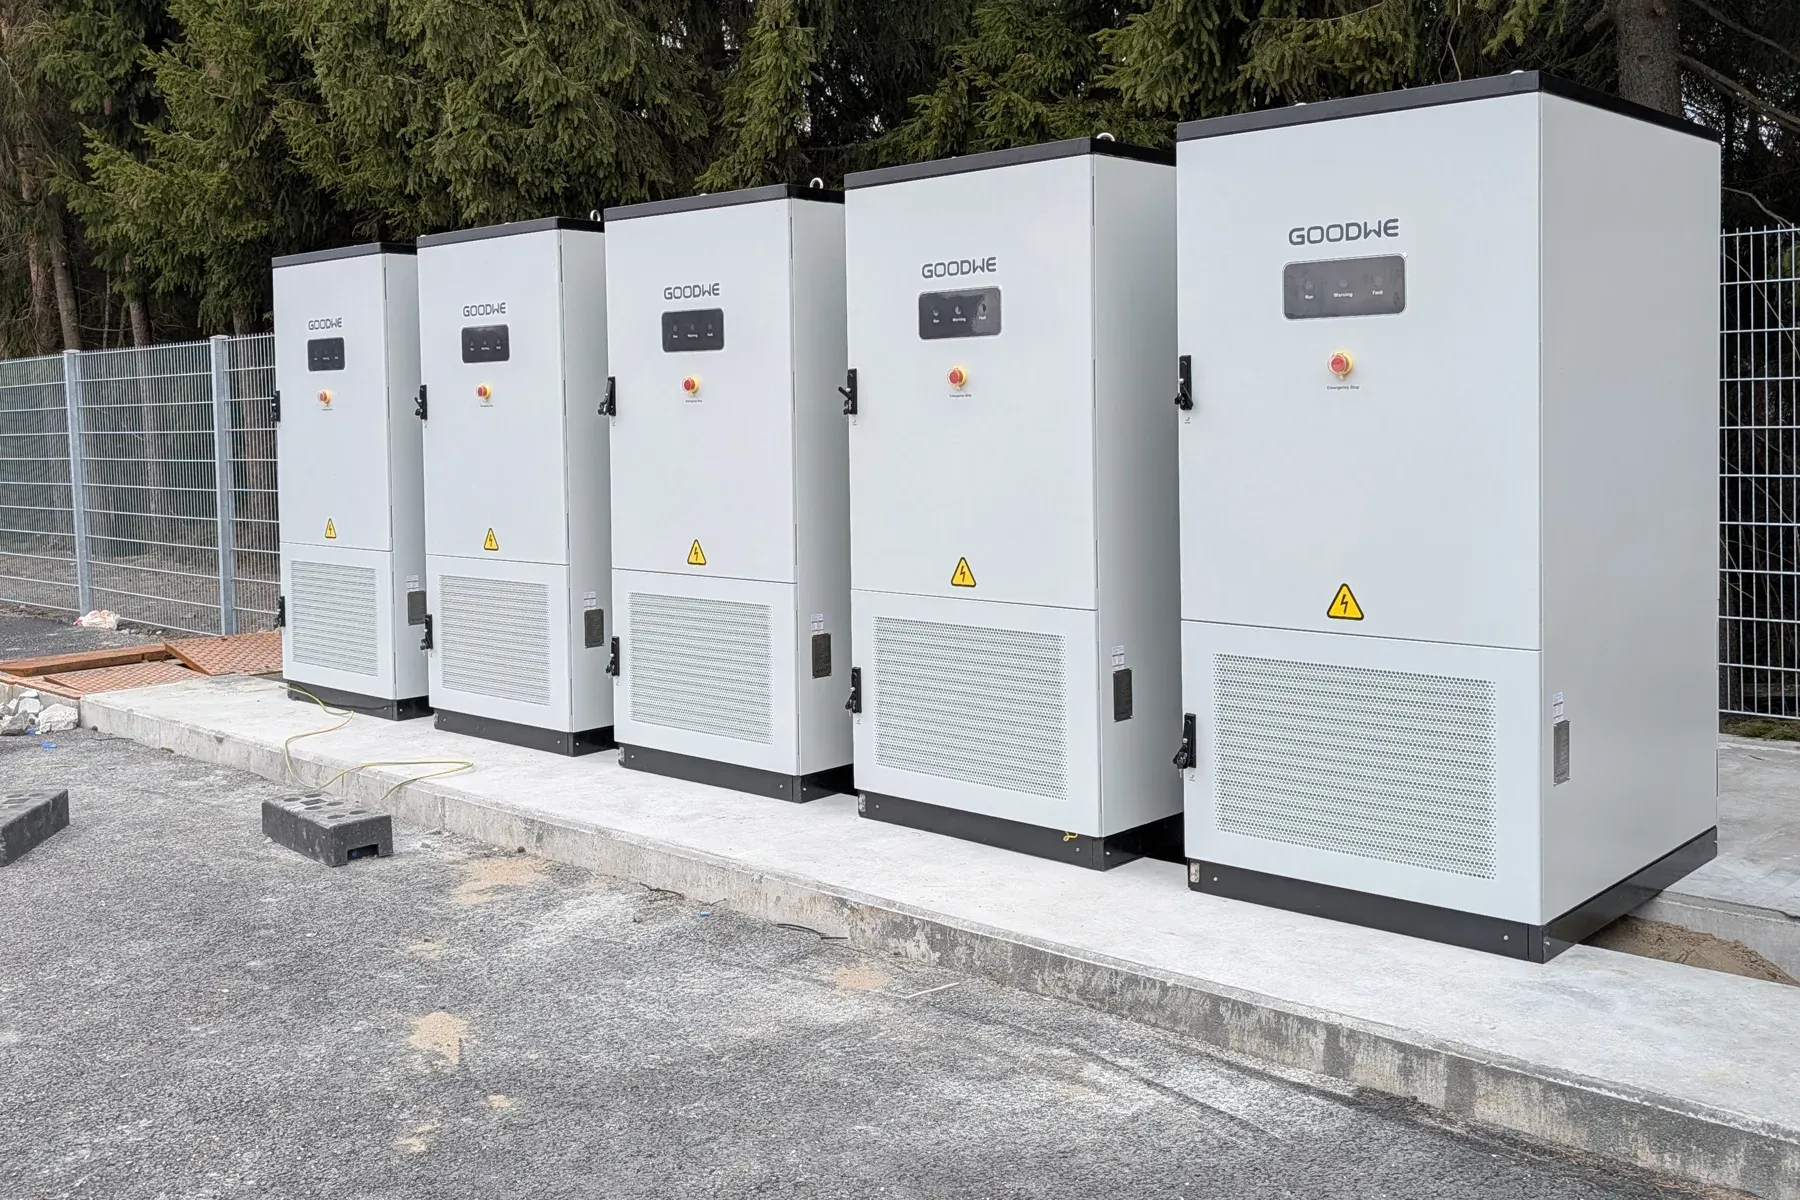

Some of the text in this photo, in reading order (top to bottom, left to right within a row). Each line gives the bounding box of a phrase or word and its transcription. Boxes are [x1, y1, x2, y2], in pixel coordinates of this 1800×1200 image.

[1288, 218, 1399, 246] GOODWE
[921, 256, 997, 279] GOODWE
[663, 282, 720, 300] GOODWE
[462, 302, 506, 317] GOODWE
[308, 317, 342, 331] GOODWE
